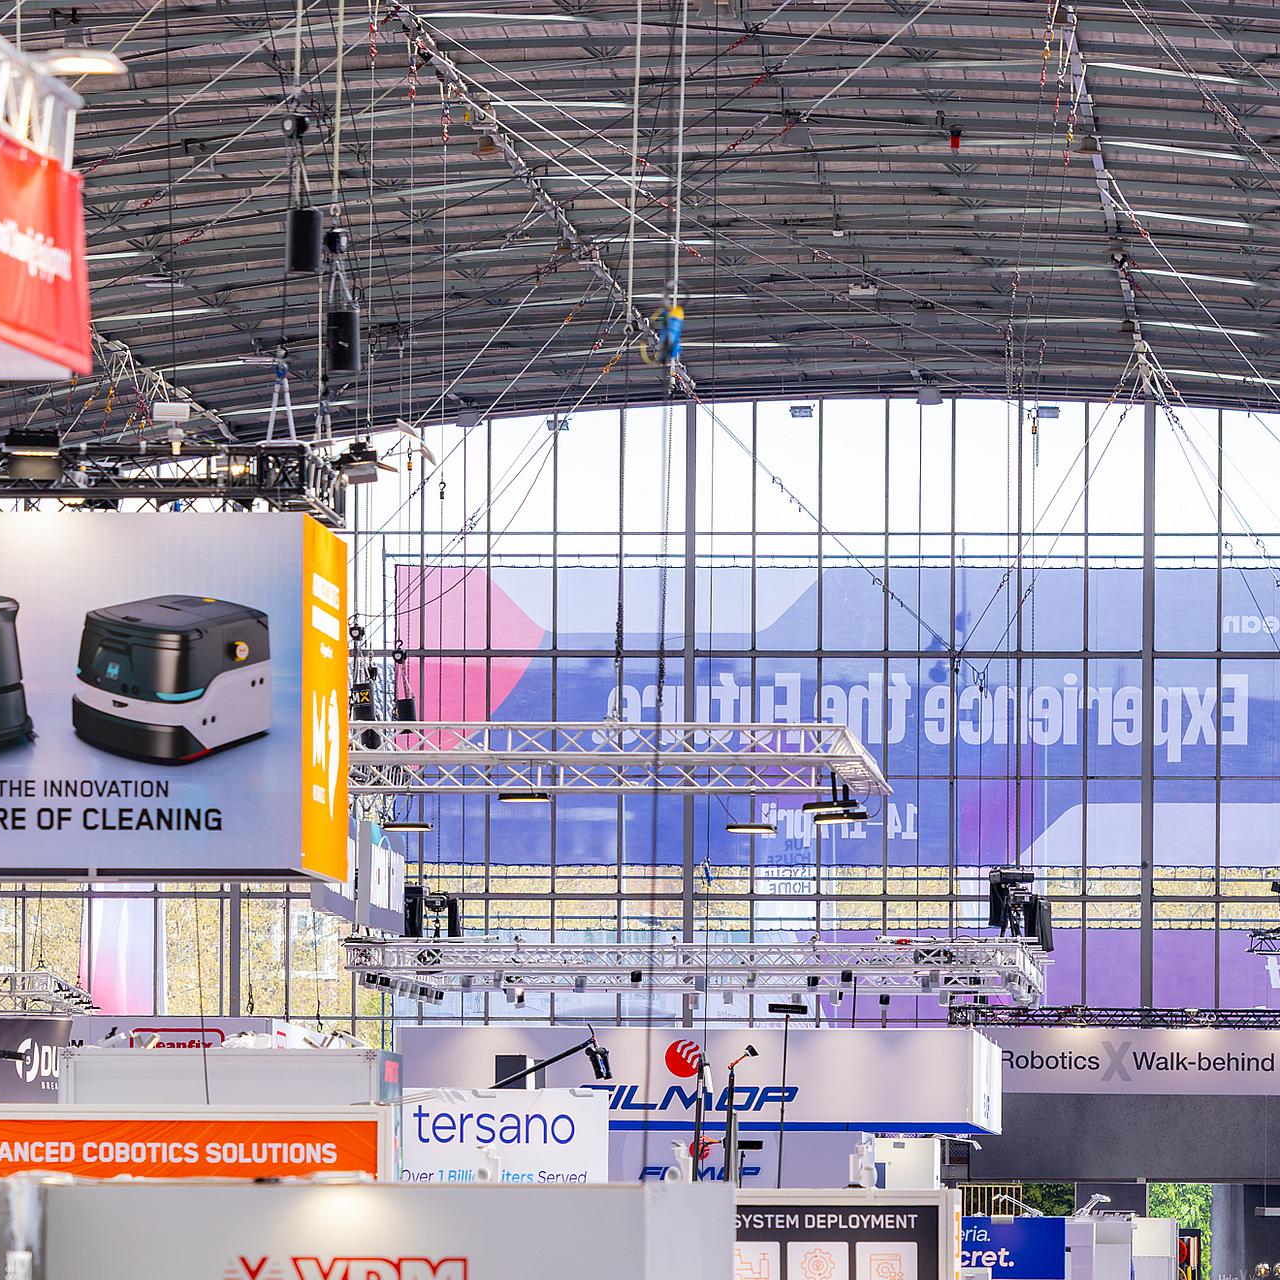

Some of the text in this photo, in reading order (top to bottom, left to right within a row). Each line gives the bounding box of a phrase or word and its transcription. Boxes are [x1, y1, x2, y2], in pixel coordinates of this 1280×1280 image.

[42, 779, 169, 798] INNOVATION
[38, 807, 71, 831] OF
[82, 807, 222, 831] CLEANING
[1001, 1040, 1276, 1083] Robotics X Walk-behind
[412, 1104, 576, 1145] tersano
[82, 1141, 200, 1163] COBOTICS
[205, 1142, 338, 1164] SOLUTIONS
[537, 1169, 588, 1183] Served
[735, 1213, 919, 1230] SYSTEM DEPLOYMENT
